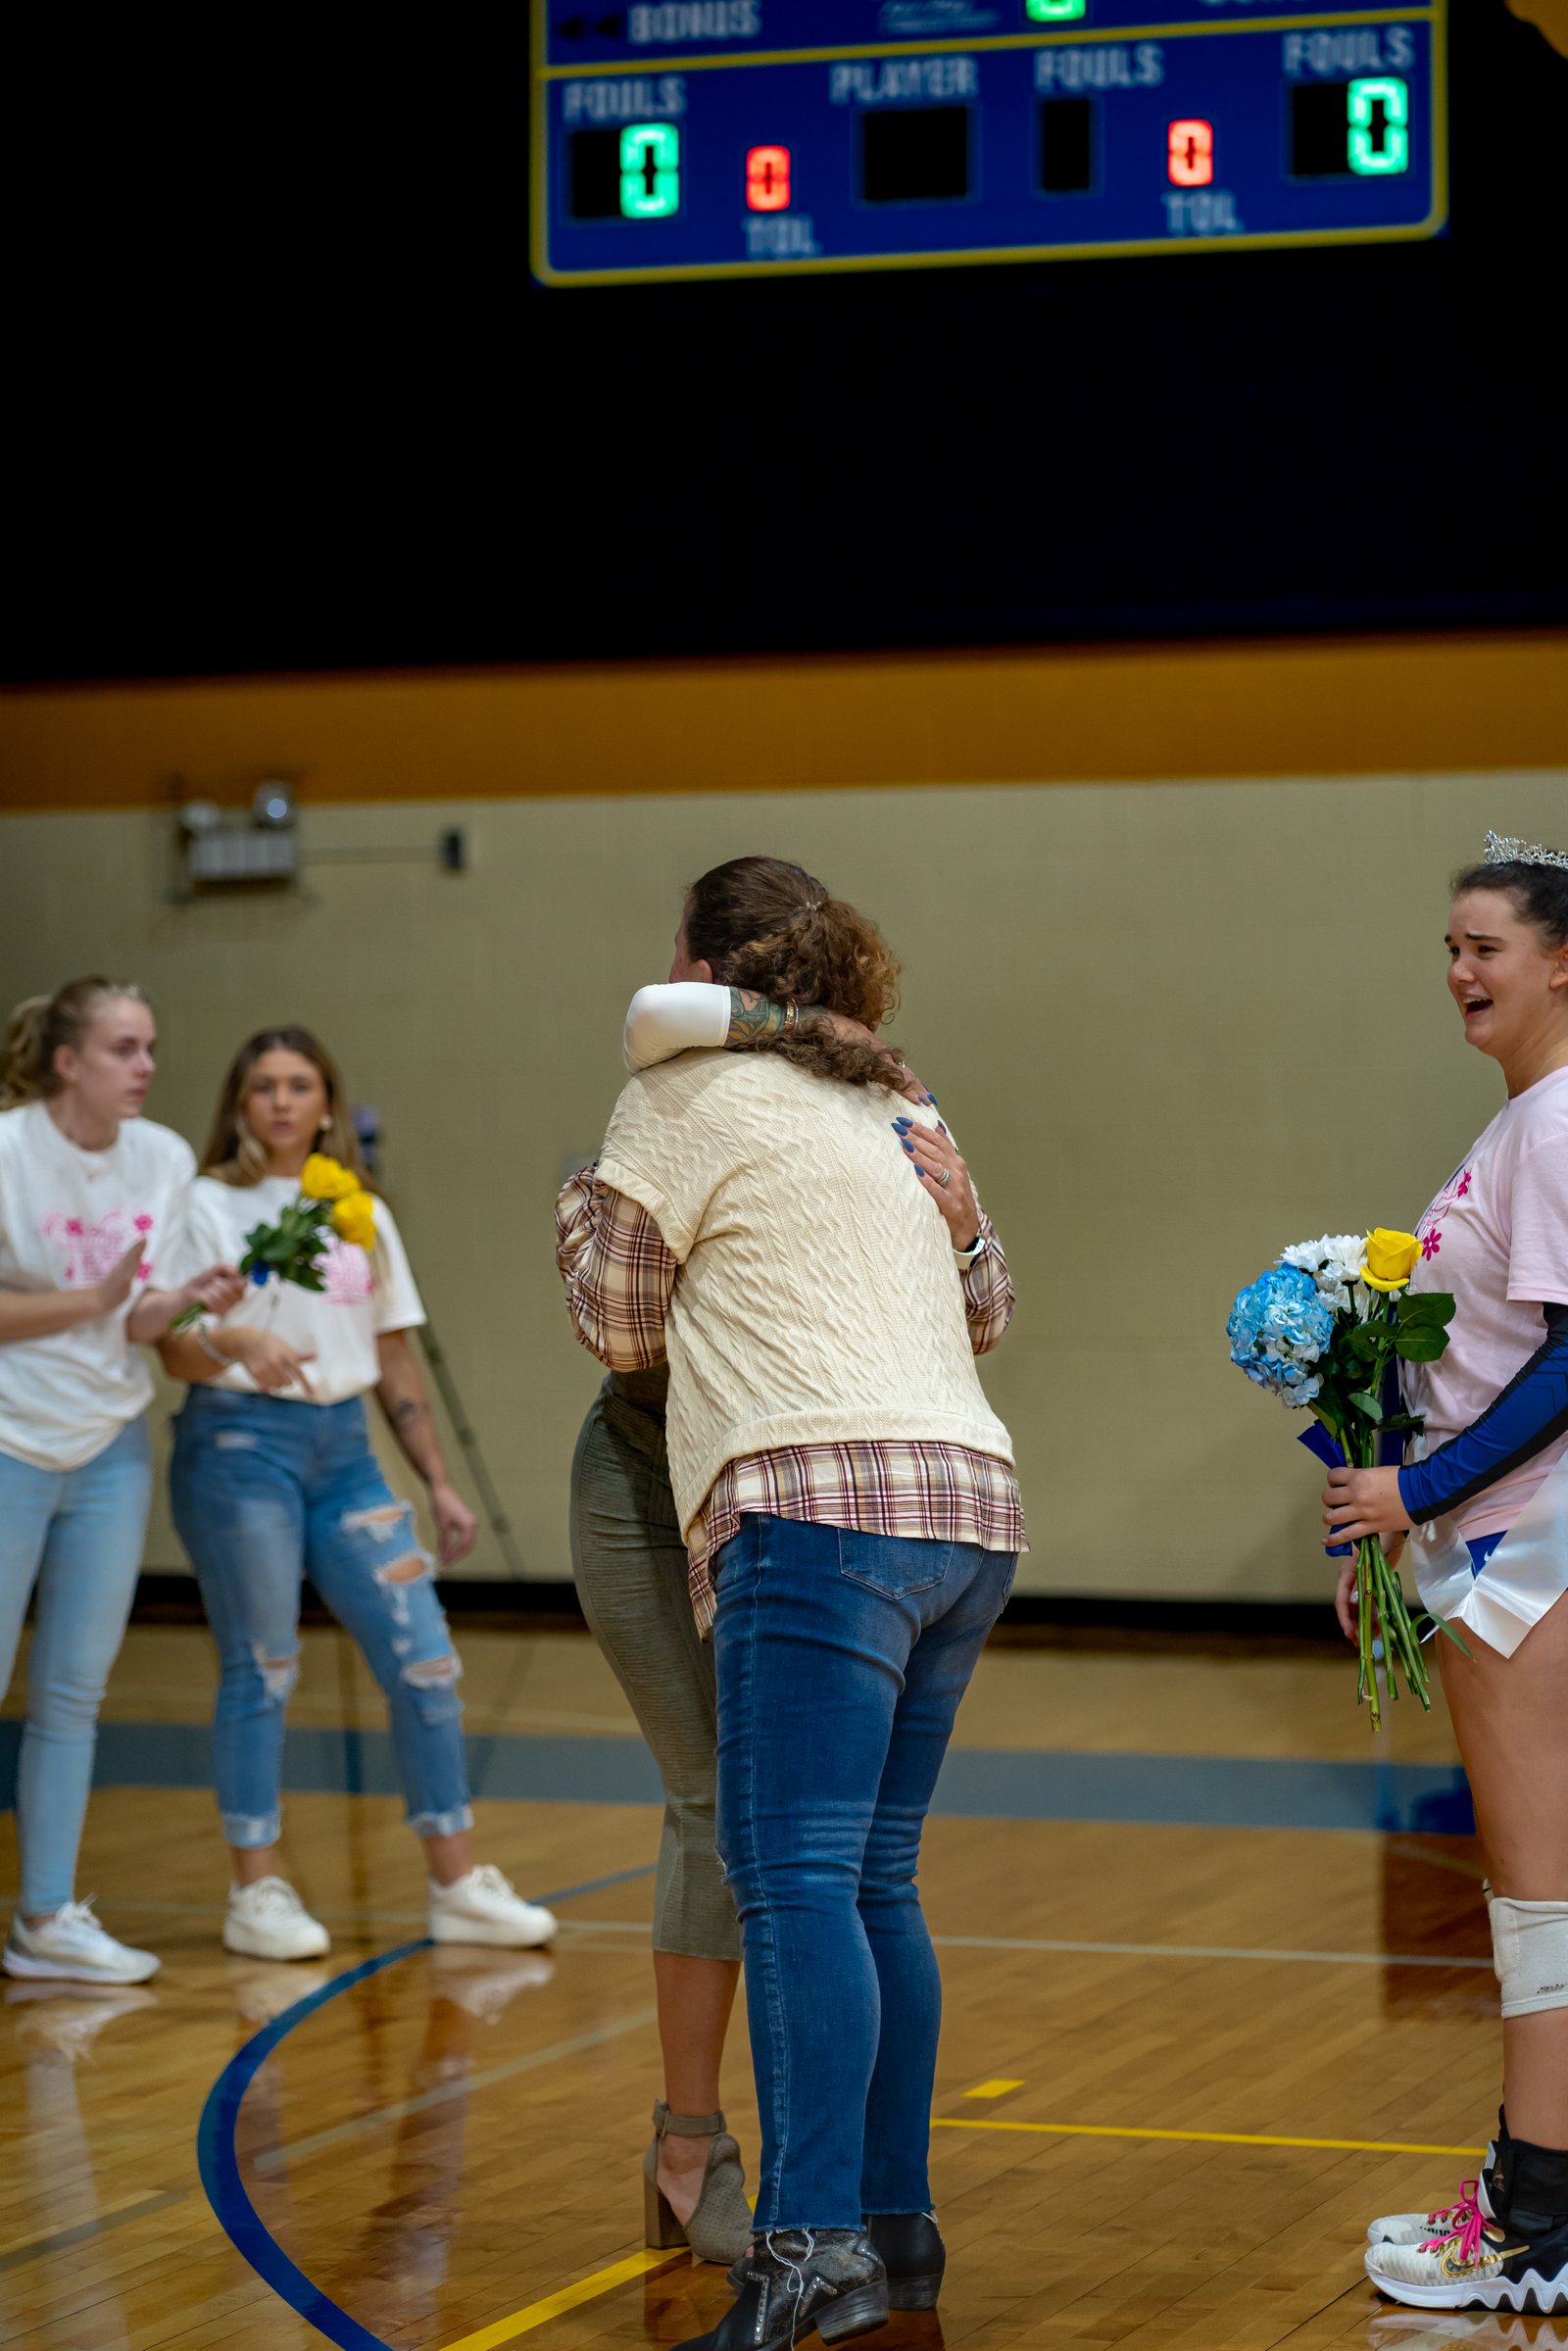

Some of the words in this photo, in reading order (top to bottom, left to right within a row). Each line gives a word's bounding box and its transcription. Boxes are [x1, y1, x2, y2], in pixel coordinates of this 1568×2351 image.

[629, 0, 760, 42] BONUS
[1036, 46, 1163, 89] FOULS
[1284, 28, 1413, 72] FOULS
[564, 79, 684, 120] FOULS
[830, 58, 977, 102] PLAYER
[1348, 77, 1407, 175] 0
[620, 123, 678, 219] 0
[1168, 119, 1213, 186] 0
[746, 145, 791, 212] 0
[1163, 193, 1243, 235] TOL
[745, 218, 819, 258] TOL
